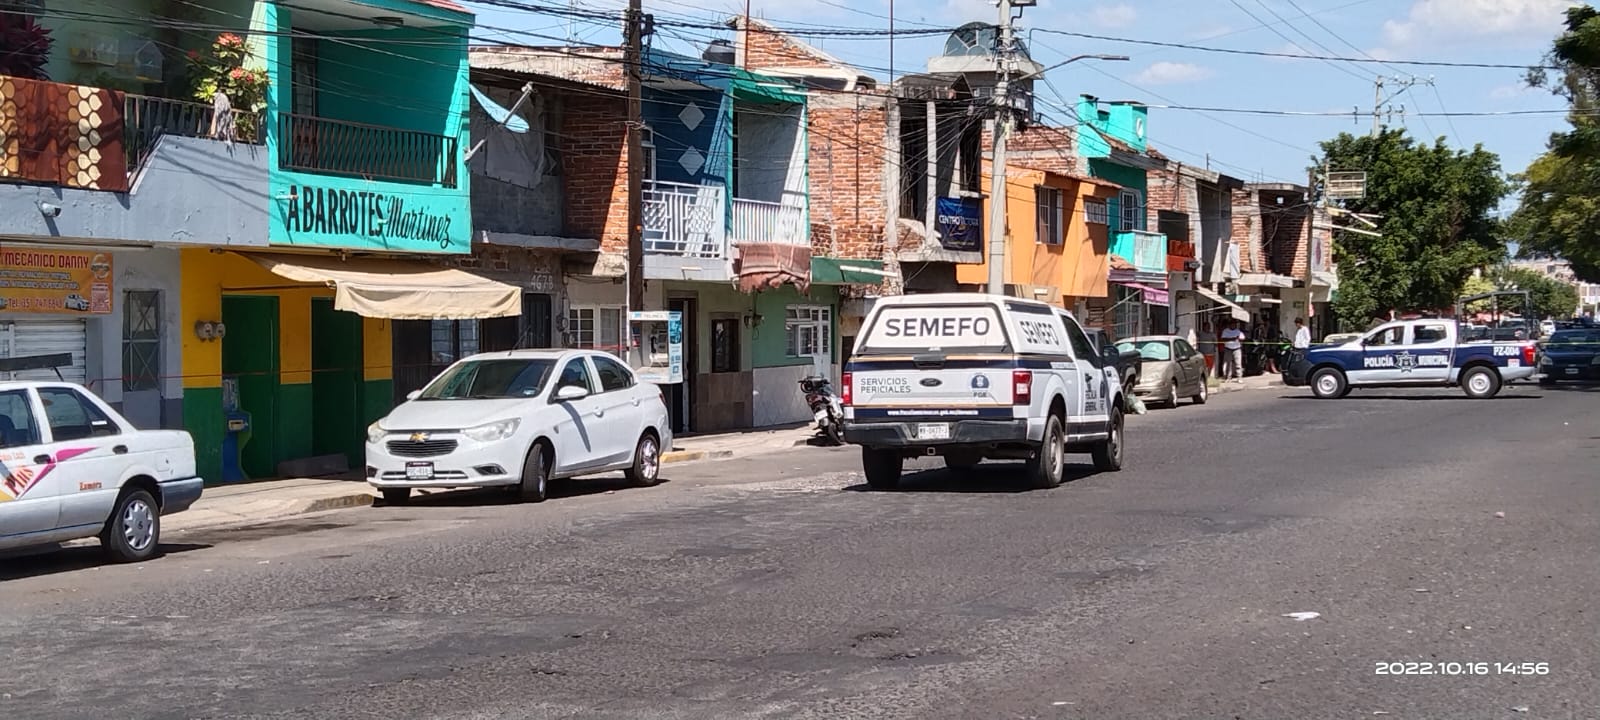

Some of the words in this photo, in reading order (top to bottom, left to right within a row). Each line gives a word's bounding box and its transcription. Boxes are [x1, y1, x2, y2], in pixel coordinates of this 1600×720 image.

[287, 185, 384, 237] ABARROTES
[939, 215, 961, 225] CENTRO
[5, 252, 55, 268] MECANICO
[59, 254, 88, 269] DANNY
[885, 317, 990, 337] SEMEFO
[1020, 321, 1060, 345] SEMEFO
[1493, 346, 1520, 356] PZ-004
[1364, 355, 1394, 367] POLICÍA
[1418, 355, 1449, 365] MUNICIPAL
